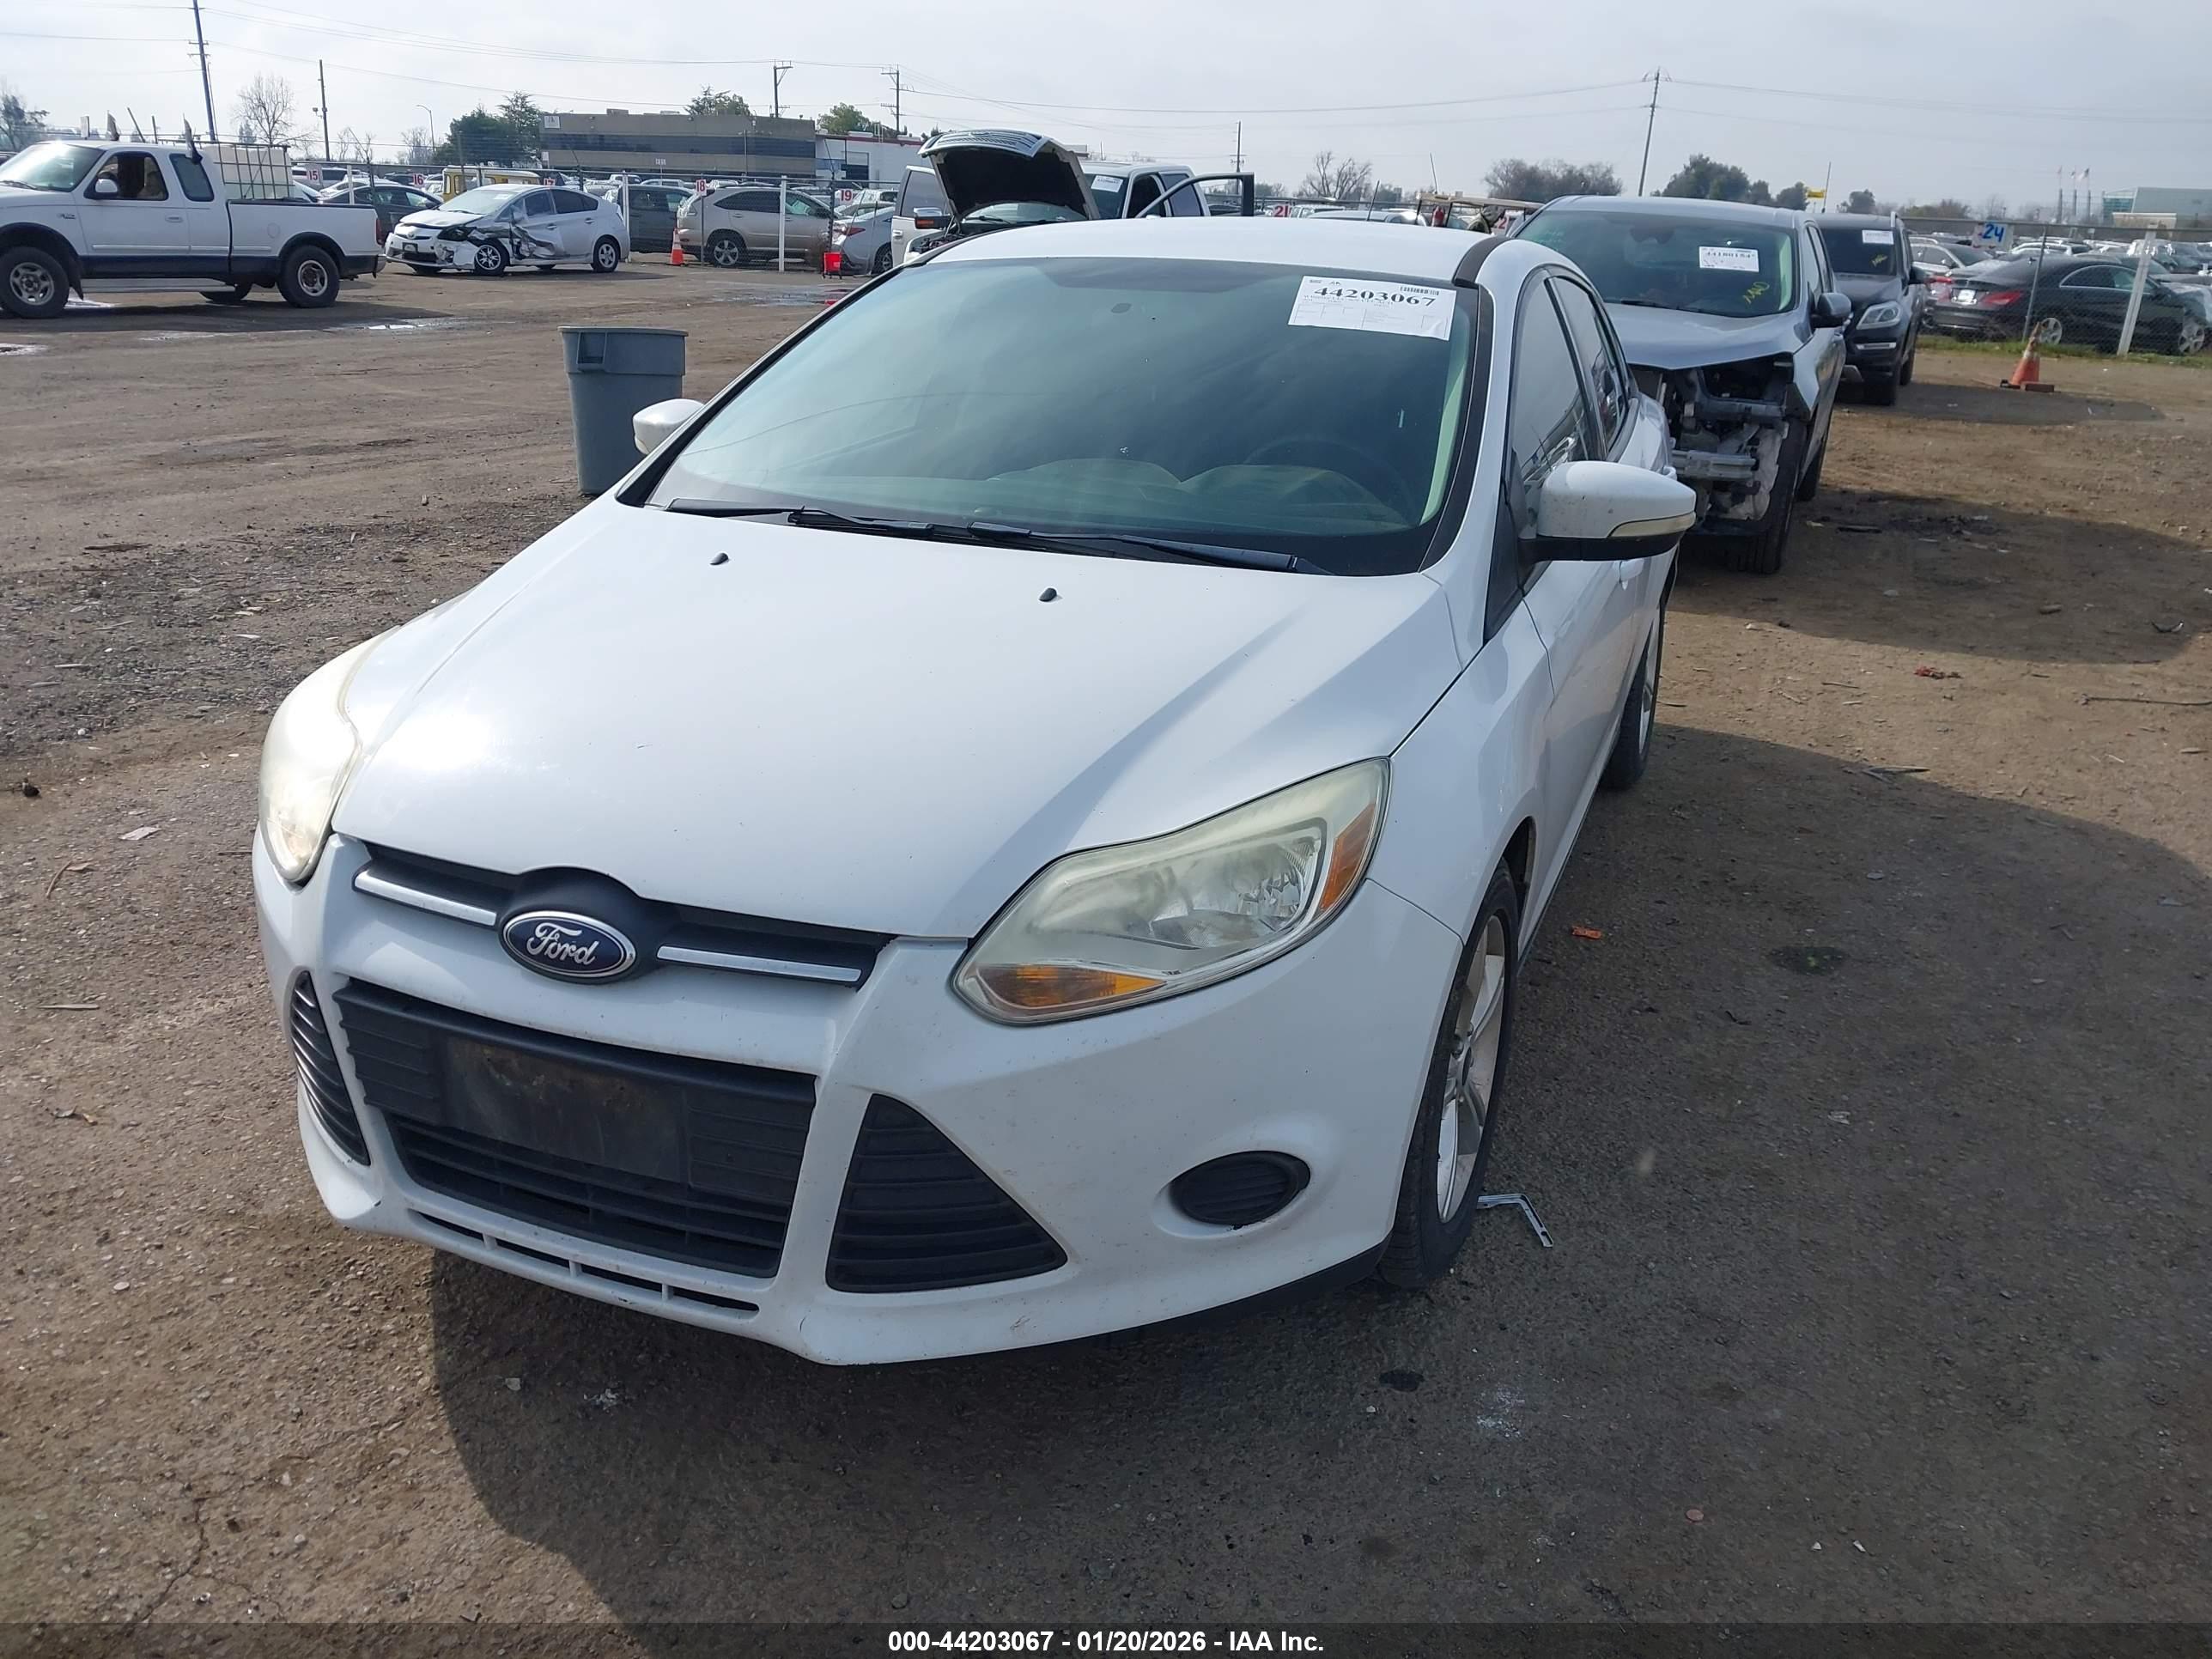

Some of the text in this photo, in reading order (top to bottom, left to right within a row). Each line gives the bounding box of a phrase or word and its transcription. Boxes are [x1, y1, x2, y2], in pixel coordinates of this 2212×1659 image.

[308, 170, 319, 180] 15
[414, 173, 424, 185] 16
[696, 180, 706, 192] 18
[841, 190, 852, 202] 19
[1274, 205, 1289, 217] 21
[1983, 223, 2004, 243] 24
[1314, 287, 1437, 307] 44203067
[526, 922, 601, 965] Ford
